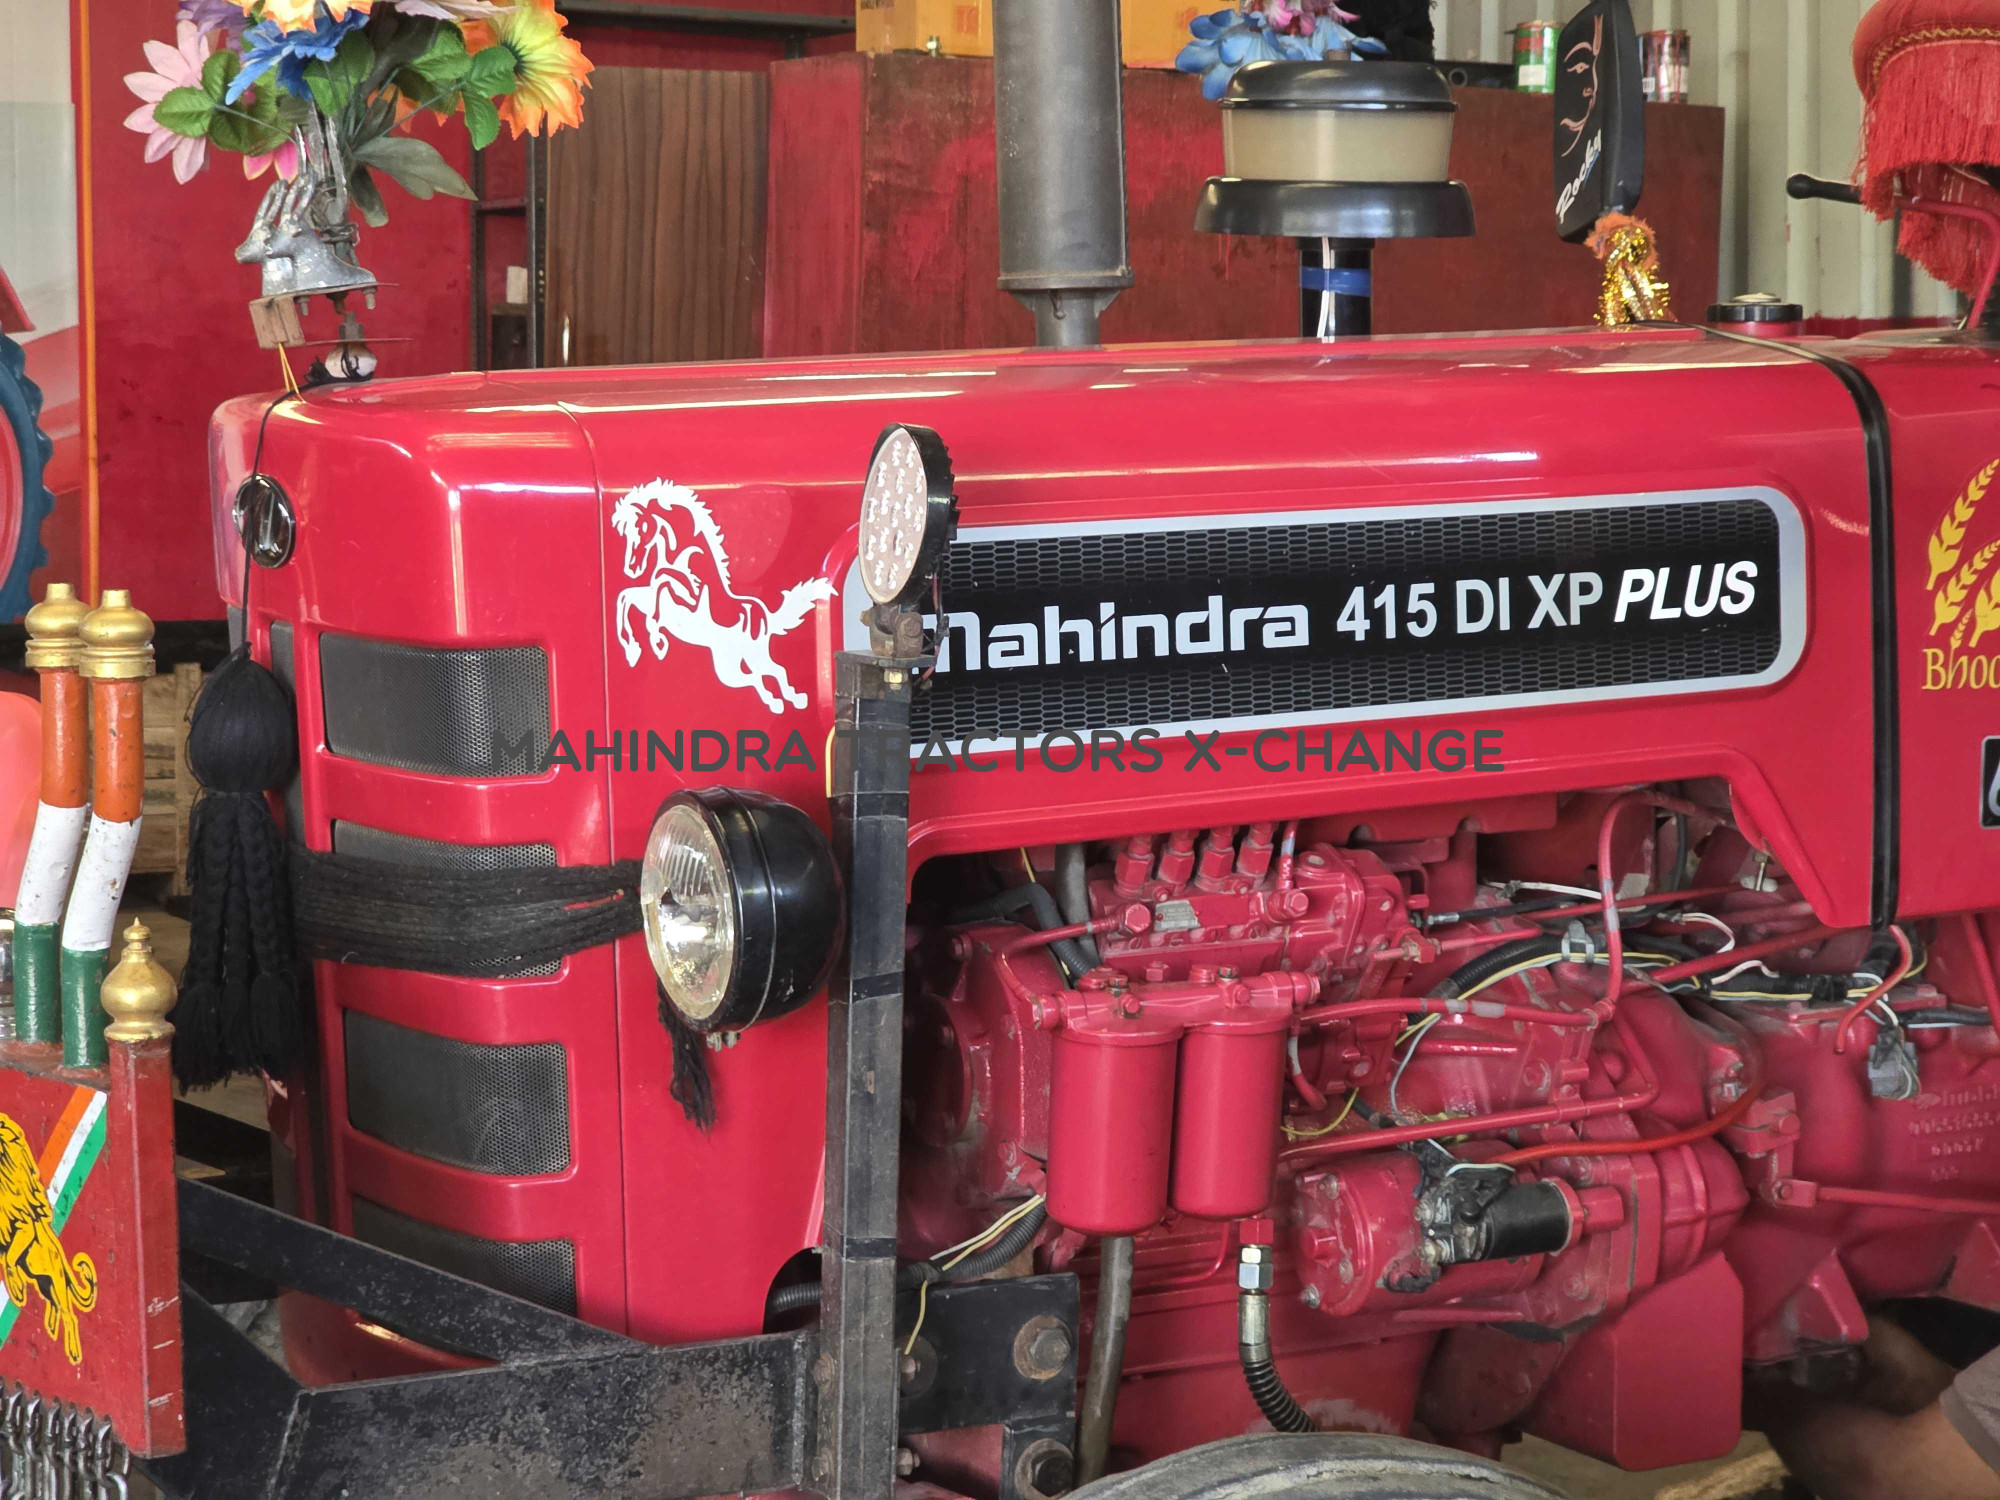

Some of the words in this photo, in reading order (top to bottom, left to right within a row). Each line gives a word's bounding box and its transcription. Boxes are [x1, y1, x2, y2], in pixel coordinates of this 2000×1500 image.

[1556, 128, 1601, 224] Rocky
[1336, 583, 1437, 641] 415
[1455, 577, 1510, 634] DI
[1527, 572, 1602, 629] XP
[1613, 560, 1758, 623] PLUS
